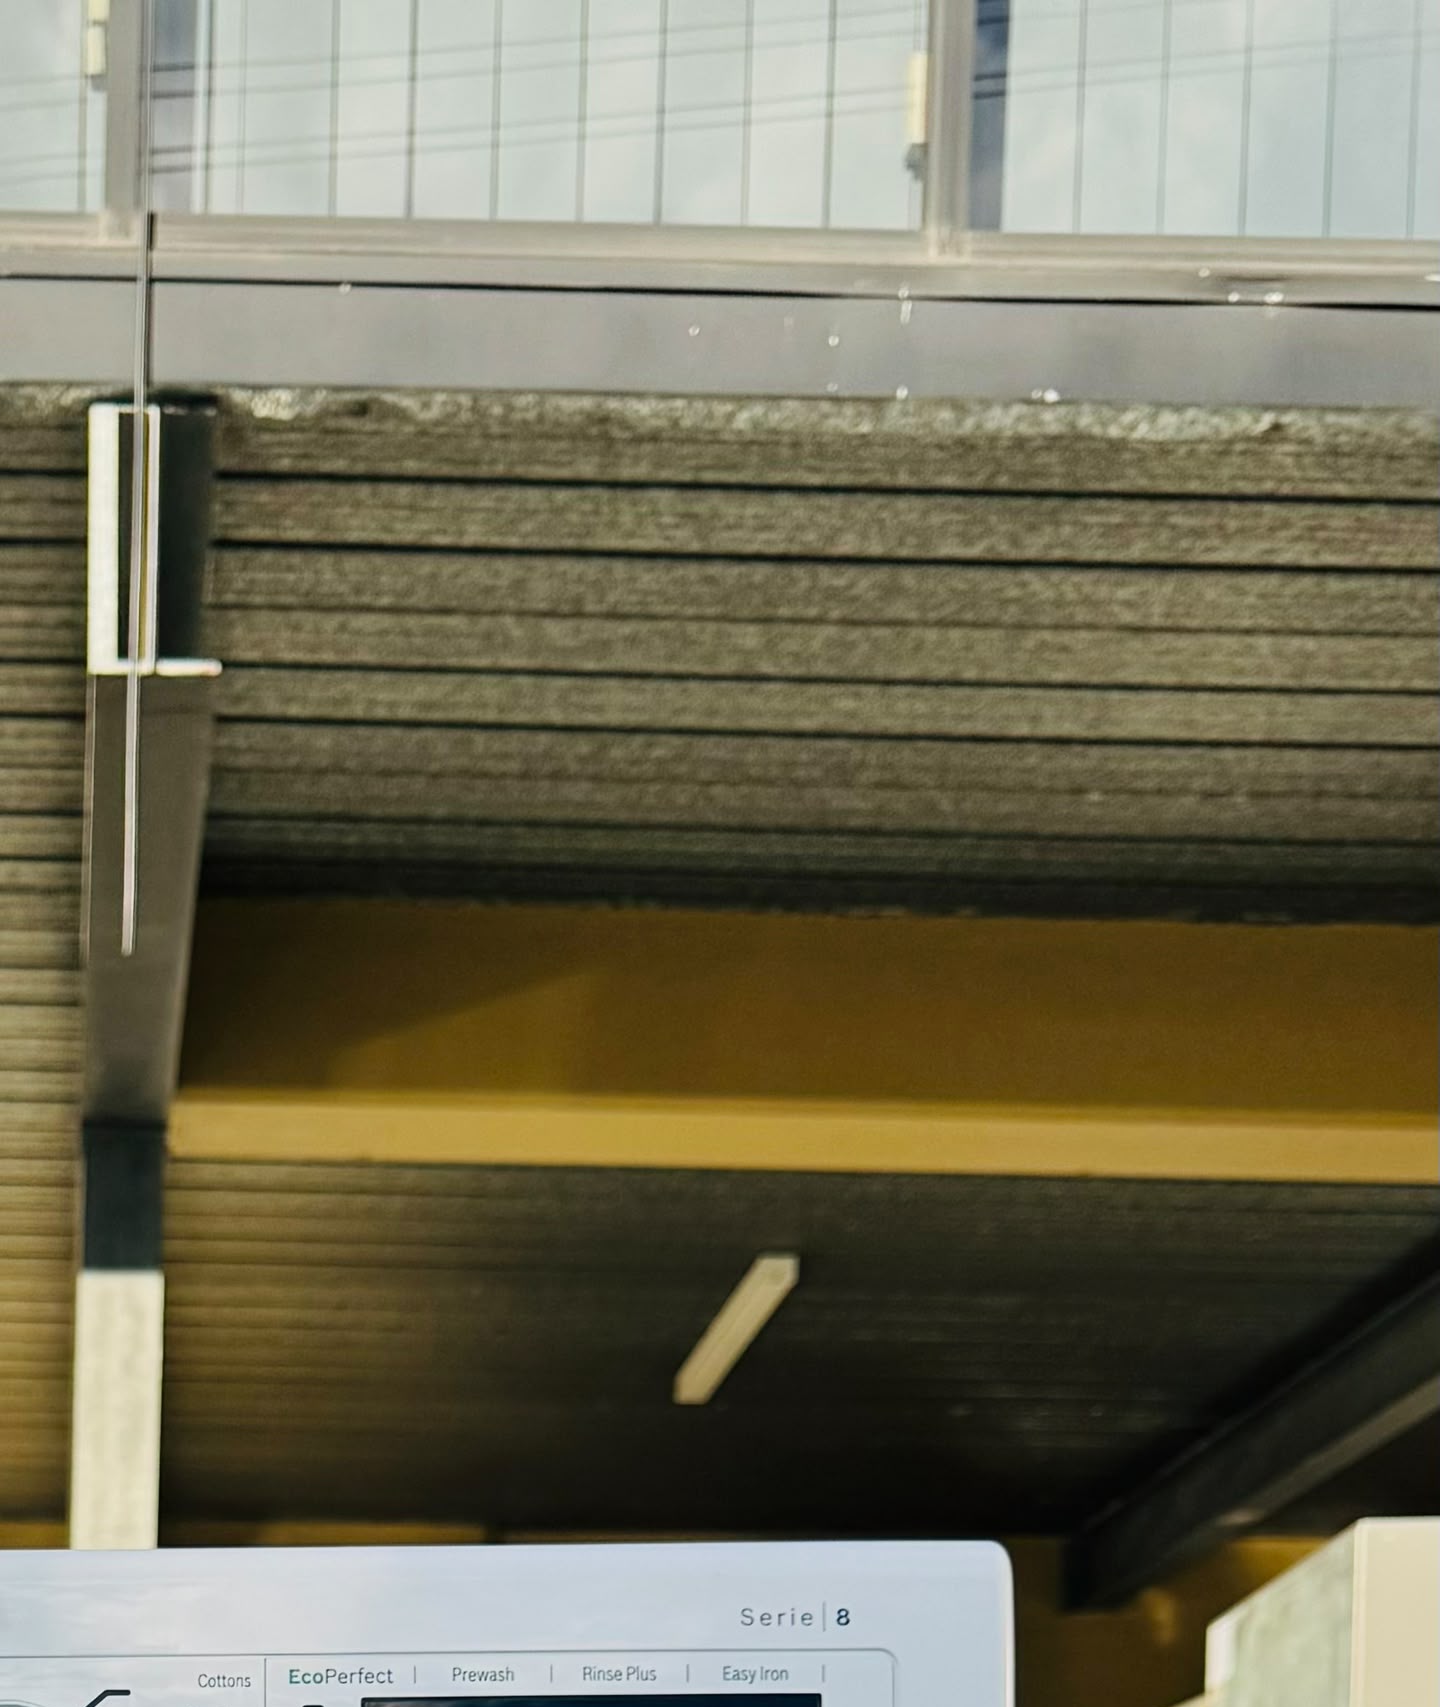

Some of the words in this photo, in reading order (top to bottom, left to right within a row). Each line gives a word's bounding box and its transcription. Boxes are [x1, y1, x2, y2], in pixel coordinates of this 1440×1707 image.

[741, 1608, 813, 1627] Serie
[836, 1608, 850, 1626] 8
[198, 1674, 251, 1688] Cottons
[289, 1668, 394, 1684] EcoPerfect
[452, 1666, 515, 1682] Prewash
[582, 1666, 623, 1681] Rinse
[626, 1666, 657, 1681] Plus
[723, 1665, 757, 1683] Easy
[760, 1665, 788, 1681] Iron
